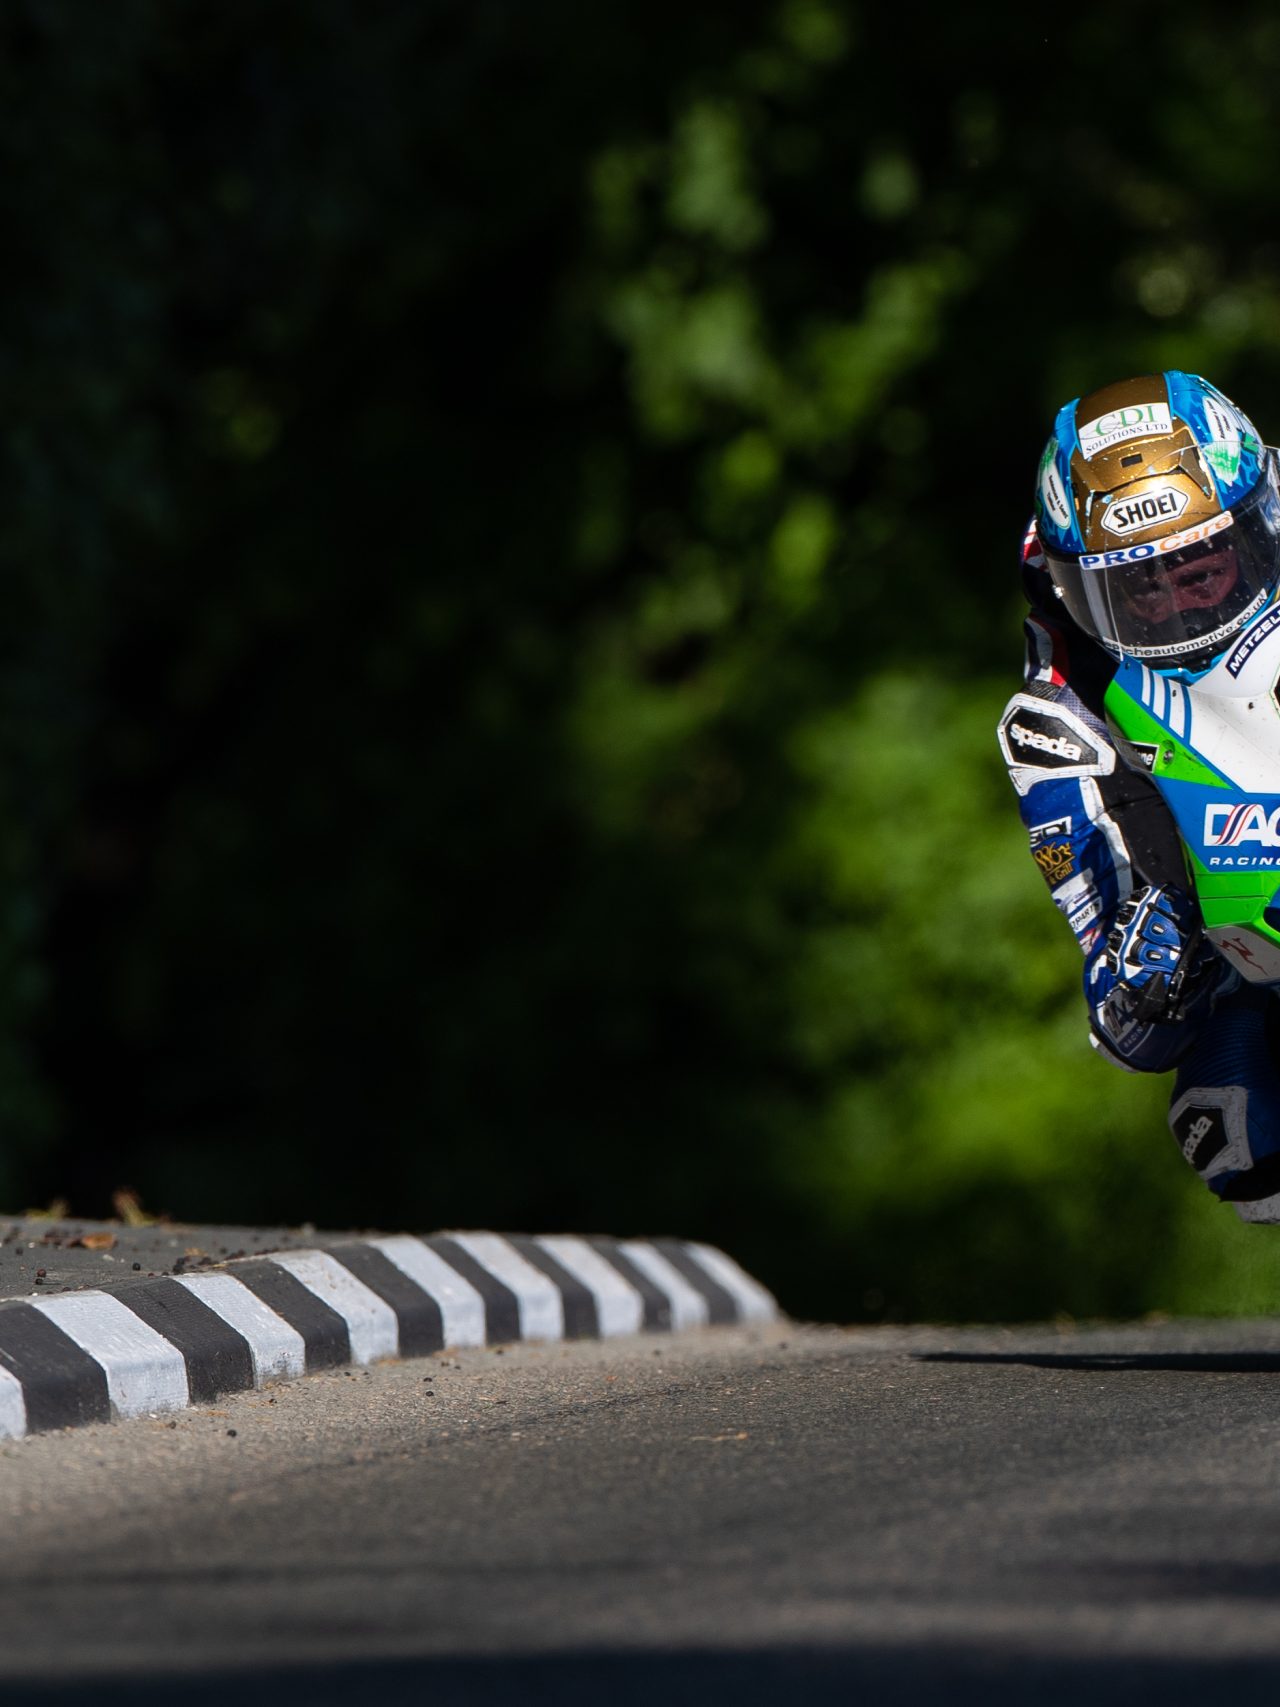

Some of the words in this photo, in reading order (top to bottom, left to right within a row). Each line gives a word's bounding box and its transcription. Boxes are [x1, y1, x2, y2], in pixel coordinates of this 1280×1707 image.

[1086, 426, 1144, 454] SOLUTIONS
[1146, 422, 1168, 432] LTD
[1095, 405, 1157, 437] CDI
[1113, 492, 1178, 529] SHOEI
[1081, 544, 1156, 569] PRO
[1159, 515, 1231, 552] Care
[1009, 723, 1082, 761] spada
[1185, 1115, 1214, 1164] pada
